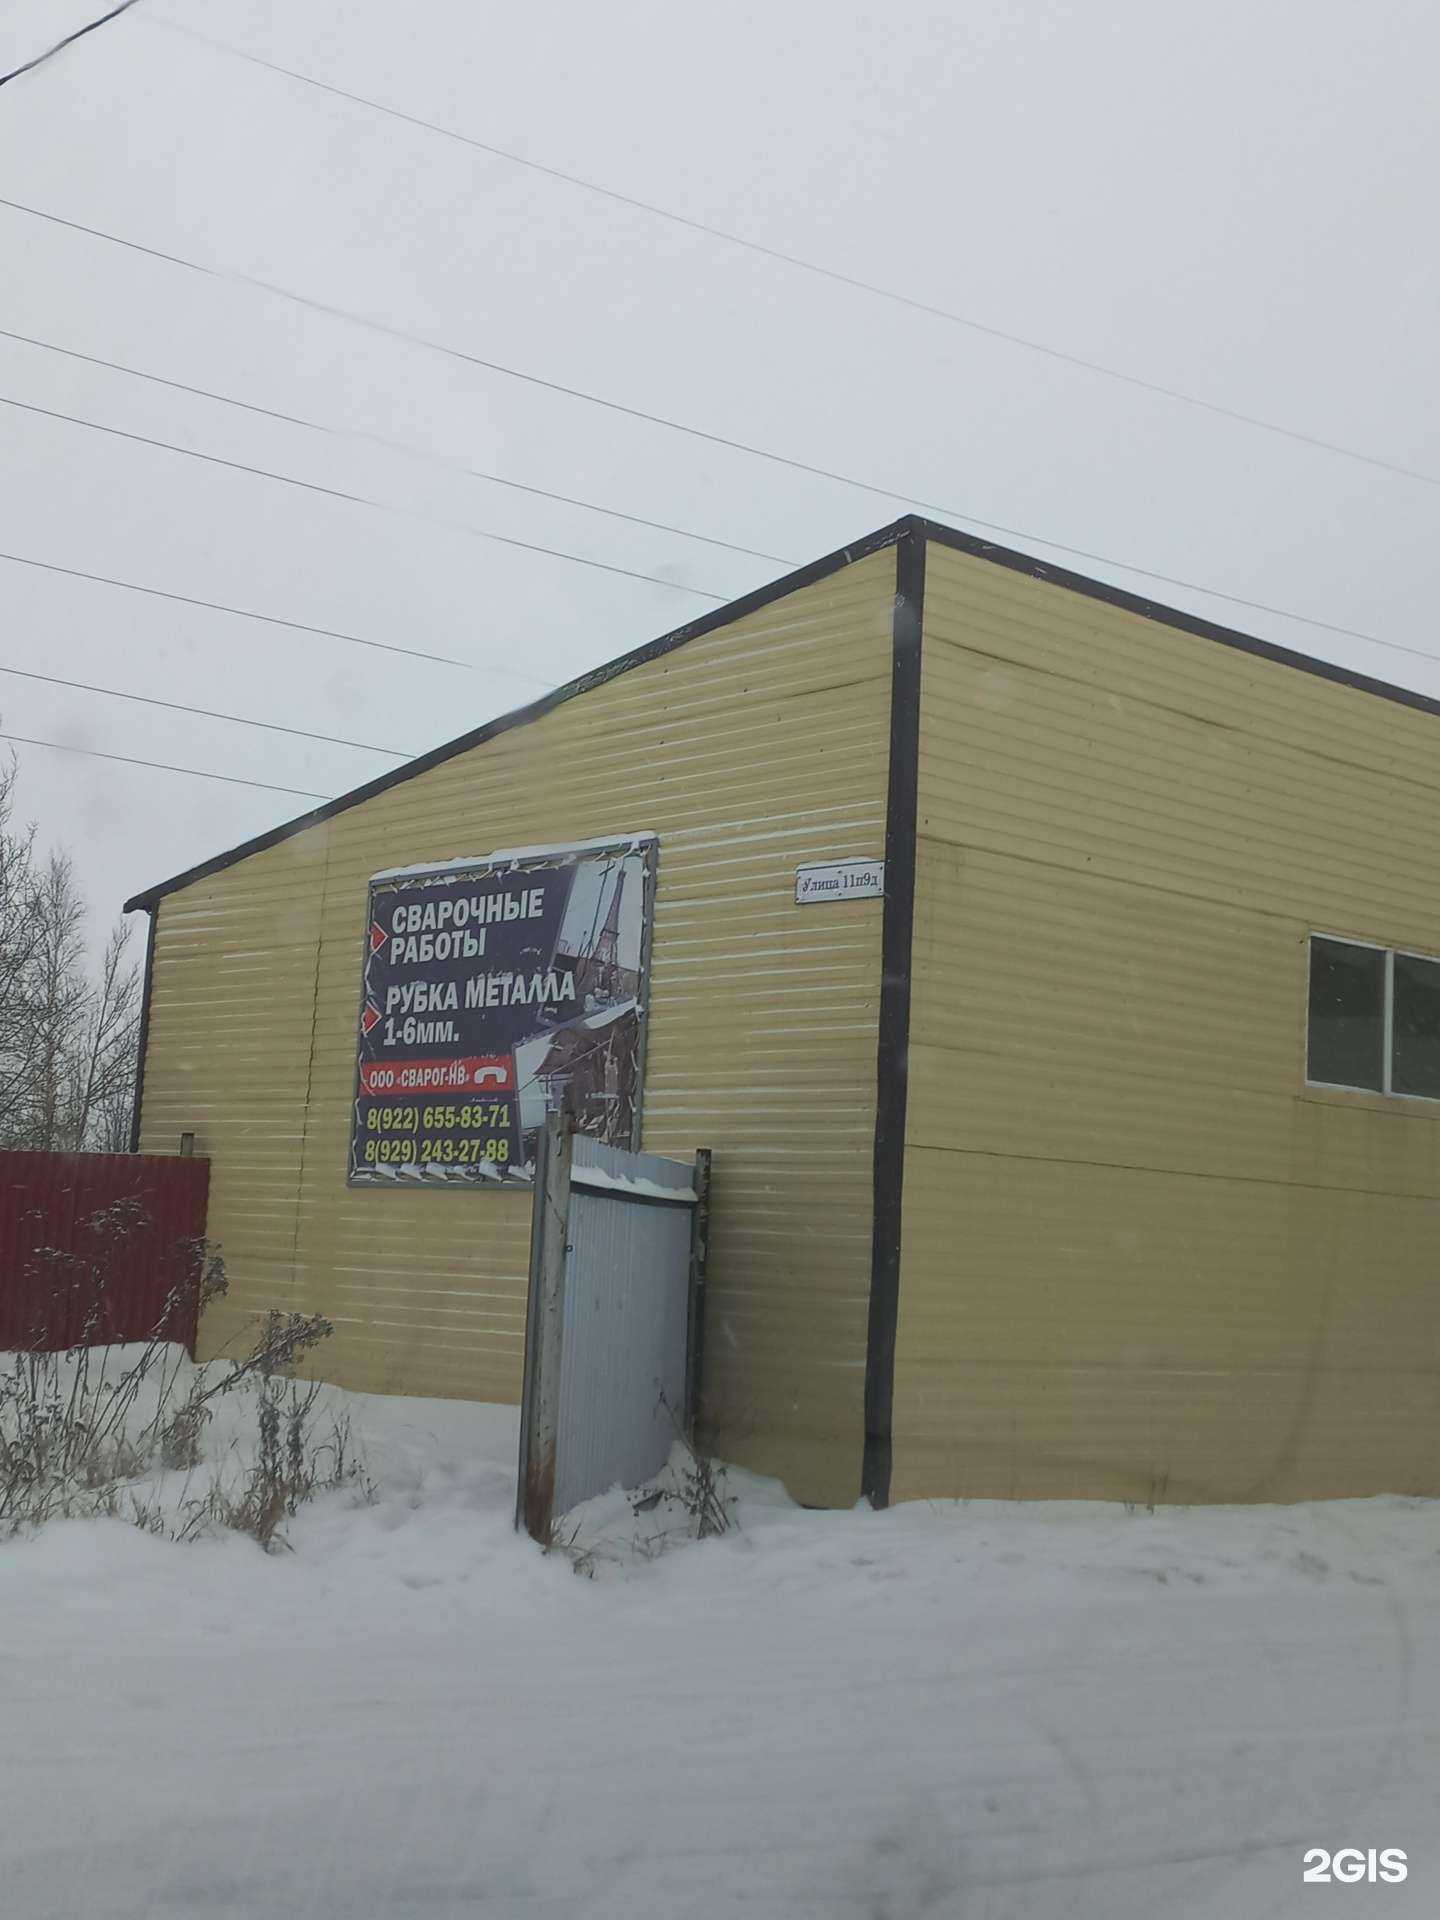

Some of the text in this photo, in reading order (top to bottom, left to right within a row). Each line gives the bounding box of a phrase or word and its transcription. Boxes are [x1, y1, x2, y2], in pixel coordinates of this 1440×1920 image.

[802, 878, 840, 892] Улица
[391, 887, 545, 934] СВАРОЧНЫЕ
[389, 927, 487, 966] РАБОТЫ
[385, 971, 577, 1015] РУБКА МЕТАЛЛА
[369, 1070, 394, 1088] ООО
[366, 1104, 511, 1134] 8(922) 655-83-71
[364, 1138, 509, 1165] 8(929) 243-27-88
